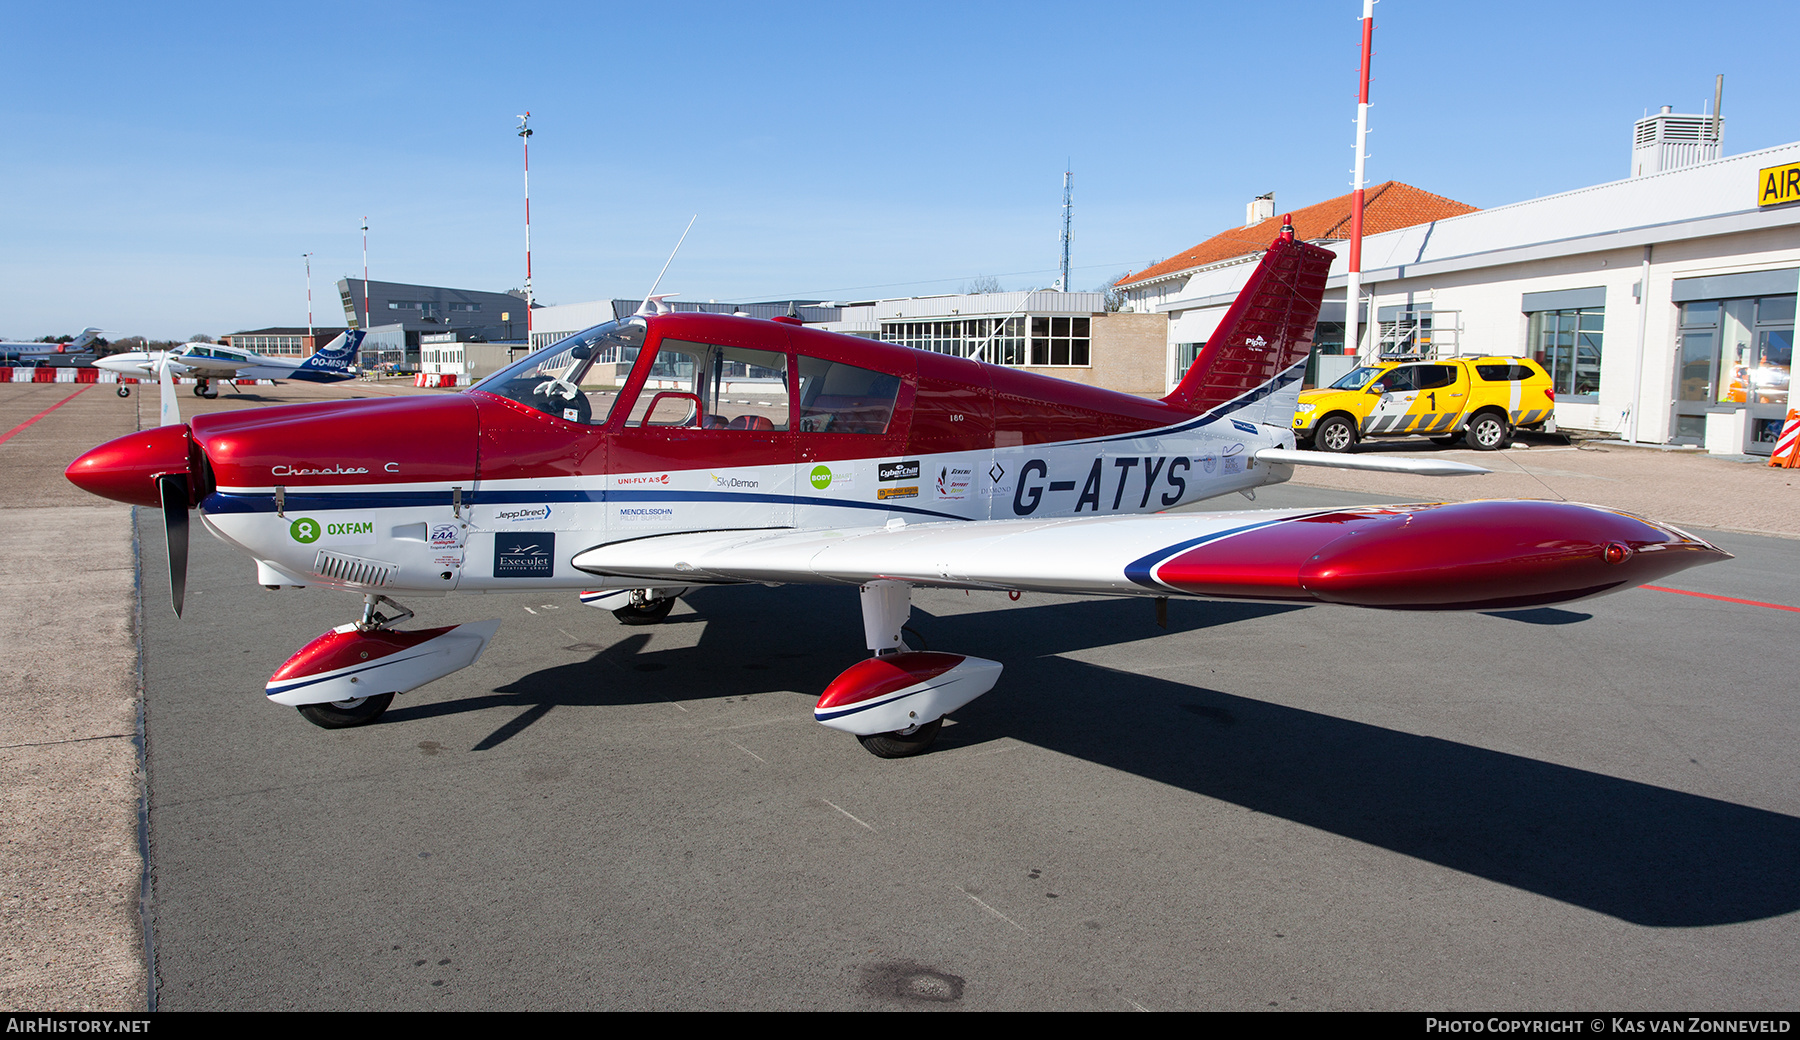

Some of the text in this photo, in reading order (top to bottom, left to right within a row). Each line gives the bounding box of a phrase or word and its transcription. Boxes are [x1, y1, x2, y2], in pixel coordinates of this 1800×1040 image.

[1245, 338, 1267, 347] Piper
[311, 357, 347, 368] OO-MSN
[1427, 391, 1436, 411] 1
[950, 414, 964, 422] 180
[271, 462, 399, 476] Cherokee C
[880, 467, 919, 478] CyberChill
[618, 477, 647, 485] UNI-FLY
[716, 478, 759, 488] SkyDemon
[811, 474, 831, 482] BODY
[1012, 456, 1190, 516] G-ATYS
[327, 522, 373, 535] OXFAM
[431, 531, 453, 540] EAA
